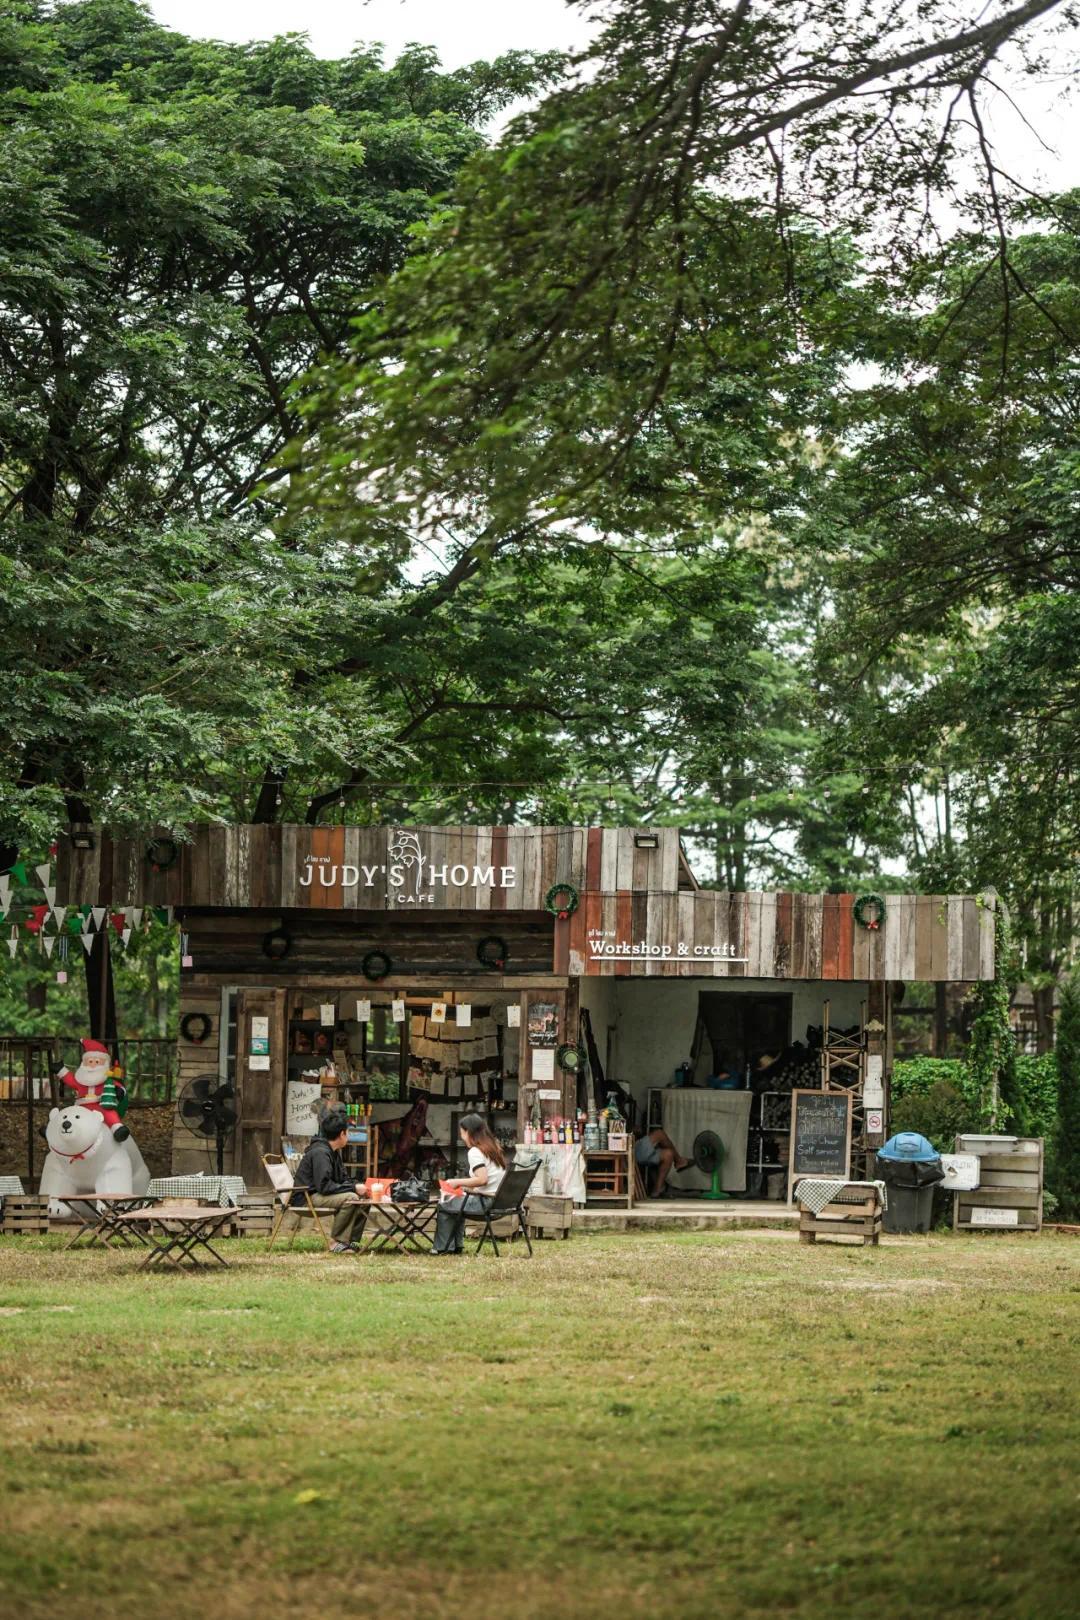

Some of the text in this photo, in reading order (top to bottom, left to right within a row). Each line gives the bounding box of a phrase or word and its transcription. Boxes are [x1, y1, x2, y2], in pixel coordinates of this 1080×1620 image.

[299, 864, 516, 888] JUDY'S HOME
[397, 894, 435, 903] CAFE
[589, 940, 736, 958] Workshop & craft
[291, 1103, 311, 1113] Hom
